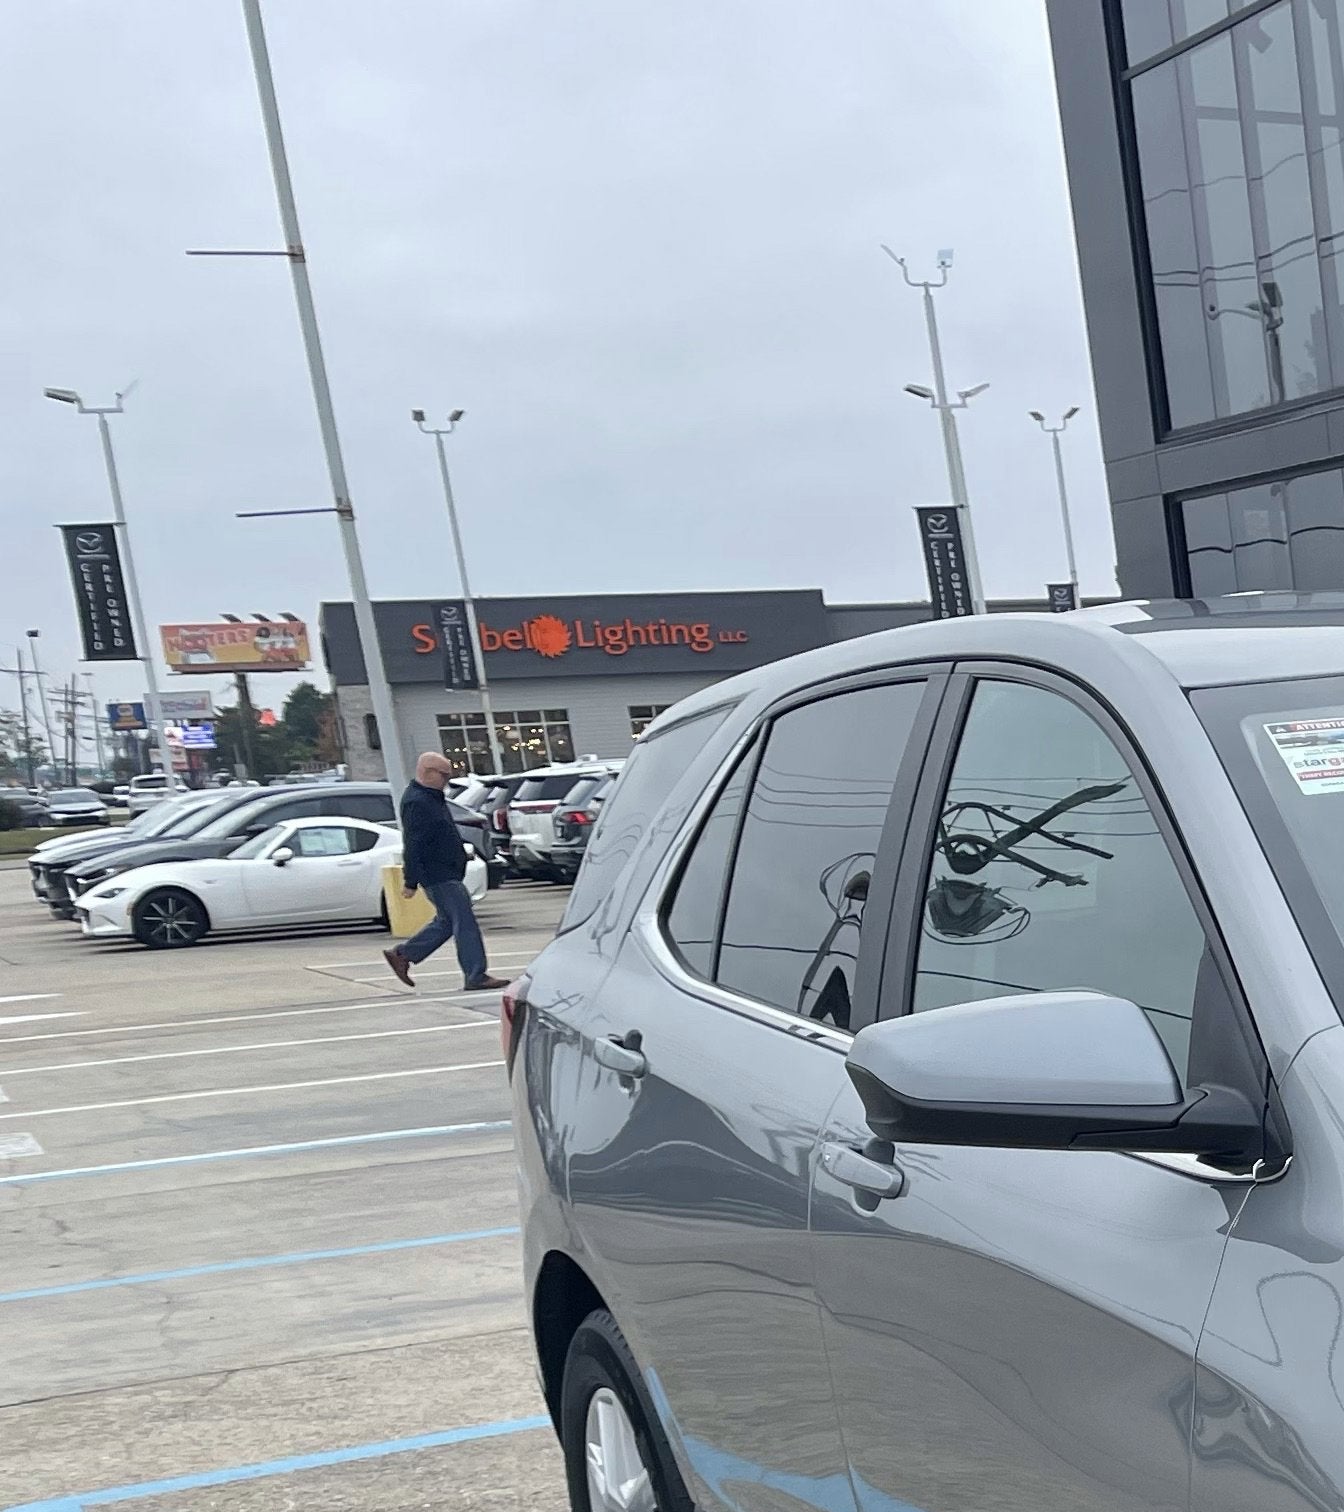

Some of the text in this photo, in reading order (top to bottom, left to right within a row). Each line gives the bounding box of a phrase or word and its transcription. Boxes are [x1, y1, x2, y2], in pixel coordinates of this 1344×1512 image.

[80, 563, 104, 650] CERTIFIED
[106, 598, 125, 647] OWNED
[574, 618, 715, 654] Lighting
[718, 630, 749, 643] LLC
